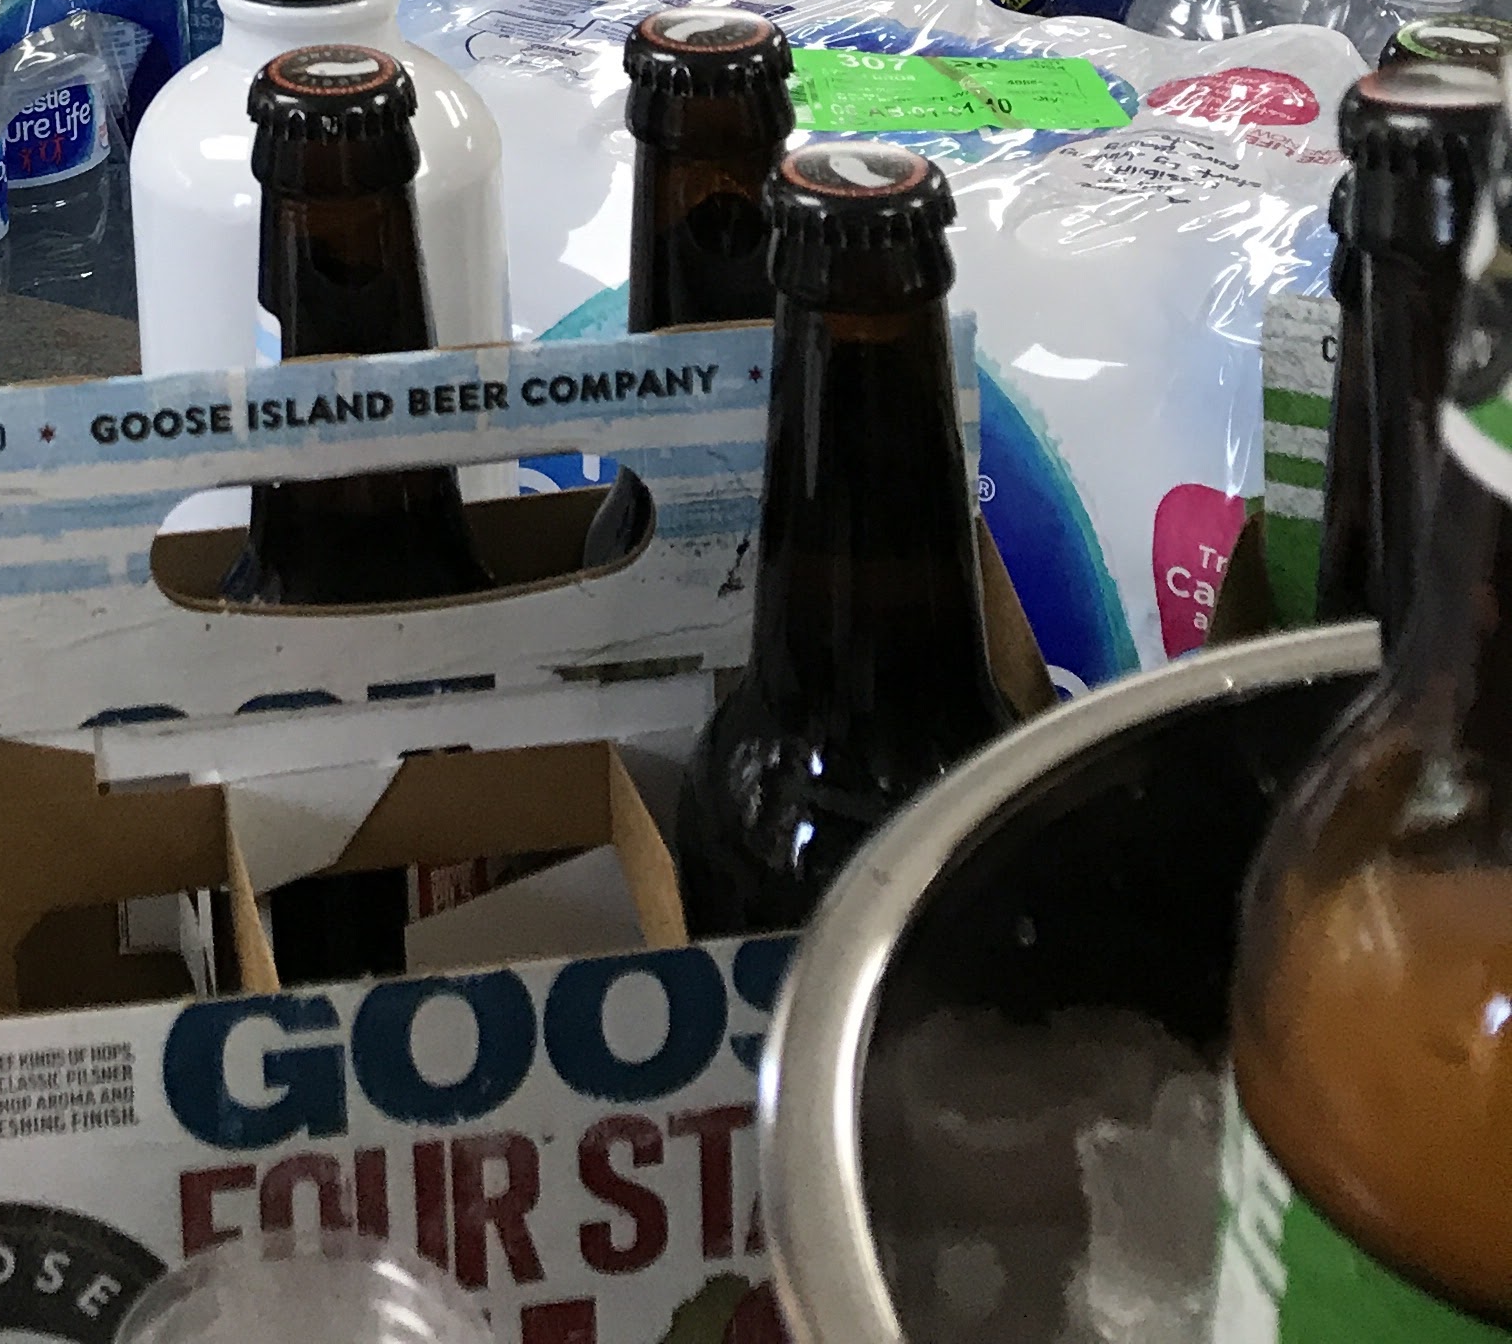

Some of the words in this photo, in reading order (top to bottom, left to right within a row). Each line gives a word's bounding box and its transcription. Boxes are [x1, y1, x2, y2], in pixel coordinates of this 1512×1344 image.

[5, 113, 51, 143] ure
[54, 102, 92, 140] Life
[89, 401, 233, 446] GOOSE
[246, 387, 394, 432] ISLAND
[407, 378, 509, 421] BEER
[519, 364, 720, 411] COMPANY
[18, 1047, 65, 1067] KINDS
[67, 1043, 88, 1064] OF
[65, 1063, 134, 1086] PILSNER
[35, 1088, 97, 1111] AROMA
[99, 1084, 135, 1106] AND
[178, 1129, 547, 1293] FOUR
